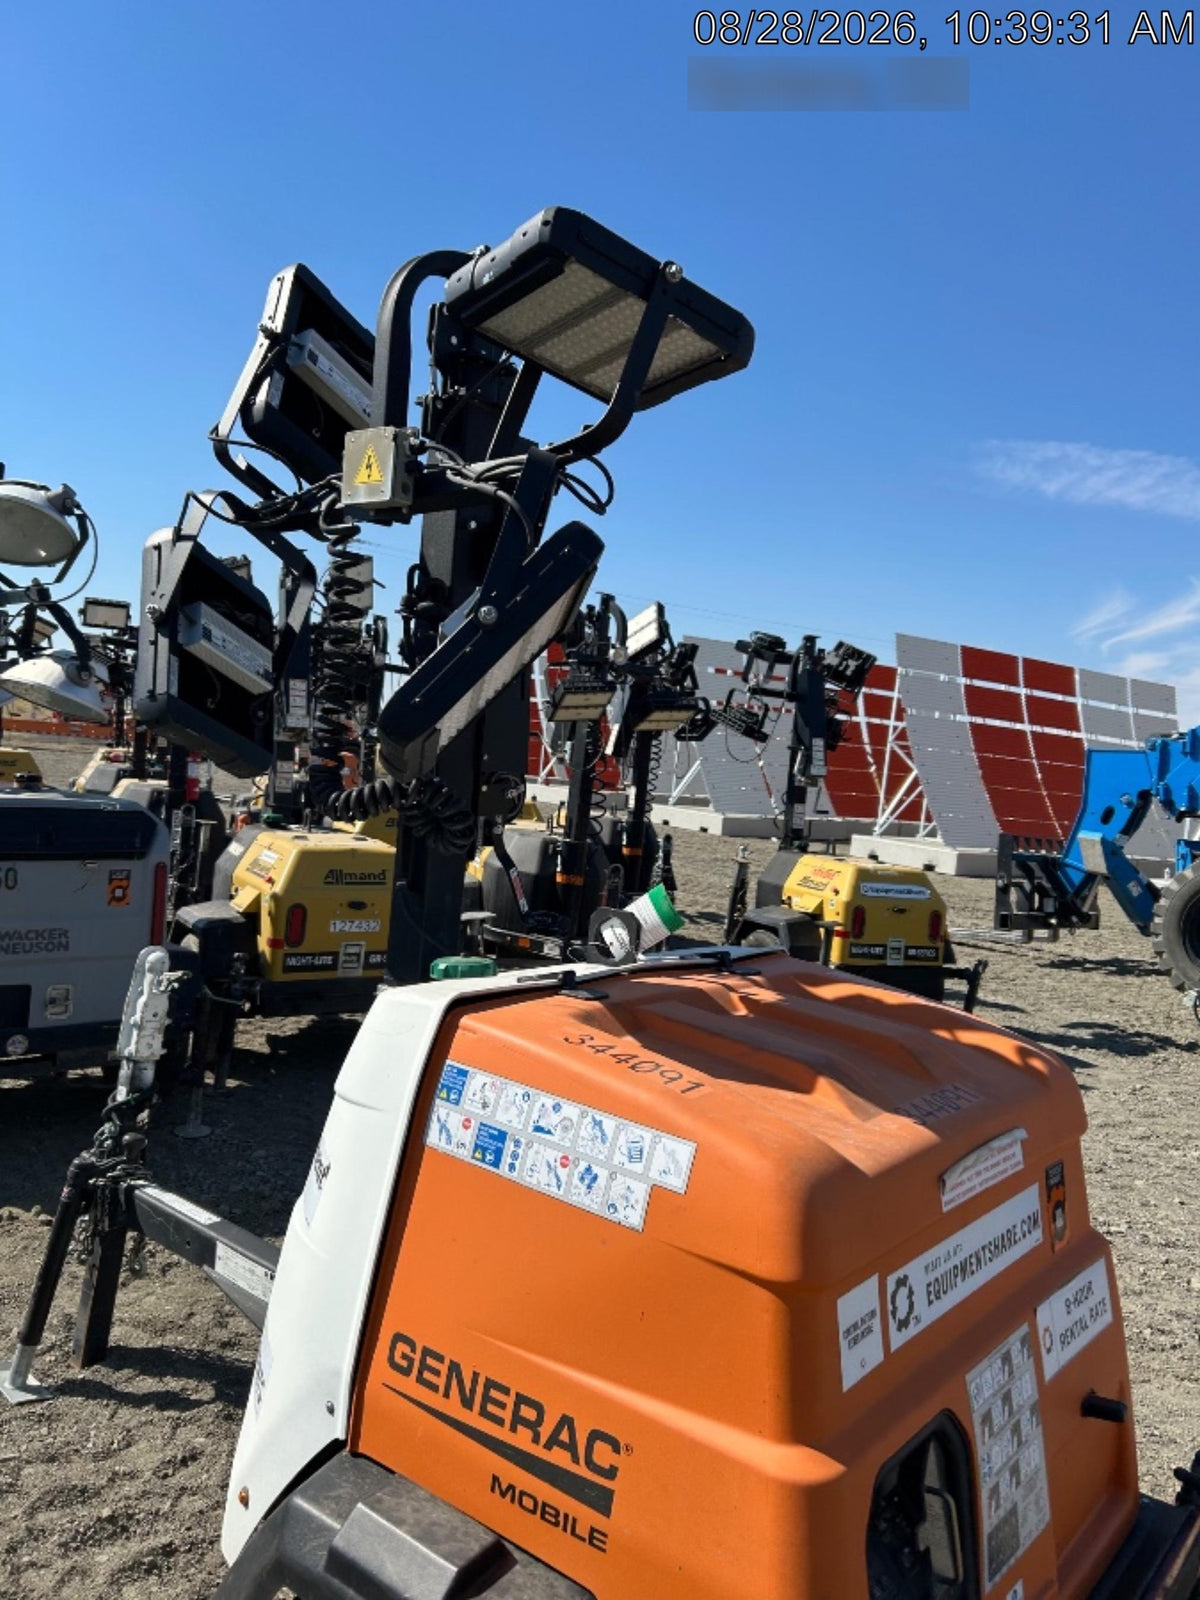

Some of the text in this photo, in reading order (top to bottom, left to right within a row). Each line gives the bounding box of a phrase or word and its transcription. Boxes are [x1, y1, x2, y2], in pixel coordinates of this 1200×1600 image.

[323, 869, 387, 883] Allmand
[0, 928, 69, 942] WACKER
[563, 1033, 705, 1095] 344091
[925, 1209, 1041, 1307] EQUIPMENTSHARE.COM
[1059, 1297, 1108, 1352] RENTAL RATE
[387, 1331, 622, 1482] GENERAC
[490, 1473, 609, 1554] MOBILE
